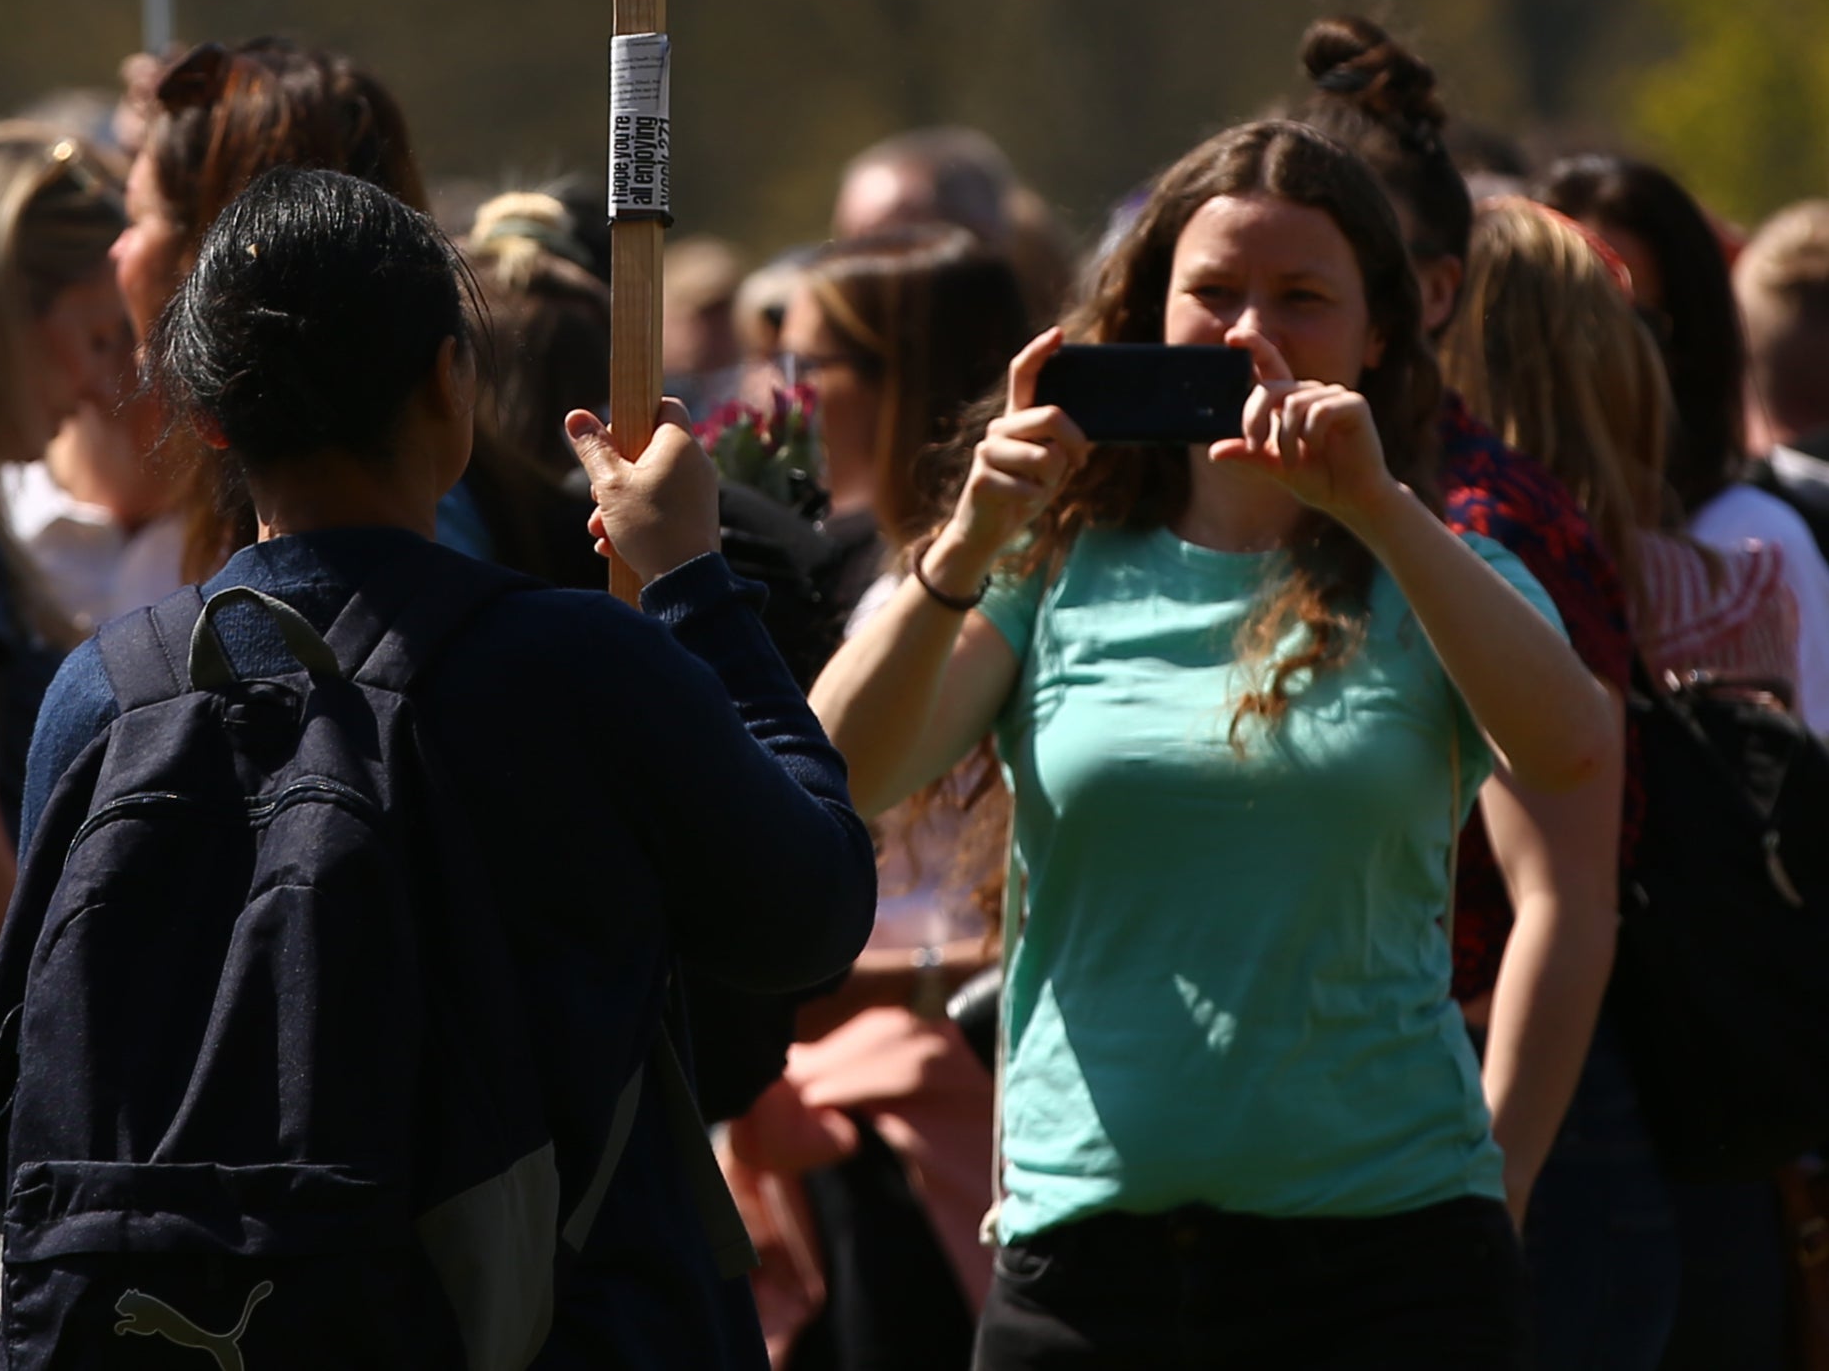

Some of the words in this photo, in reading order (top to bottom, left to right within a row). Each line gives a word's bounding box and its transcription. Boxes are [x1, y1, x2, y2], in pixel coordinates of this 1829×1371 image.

[613, 115, 632, 159] you're
[630, 116, 658, 185] enjoying
[611, 162, 631, 197] hope
[630, 187, 654, 205] all
